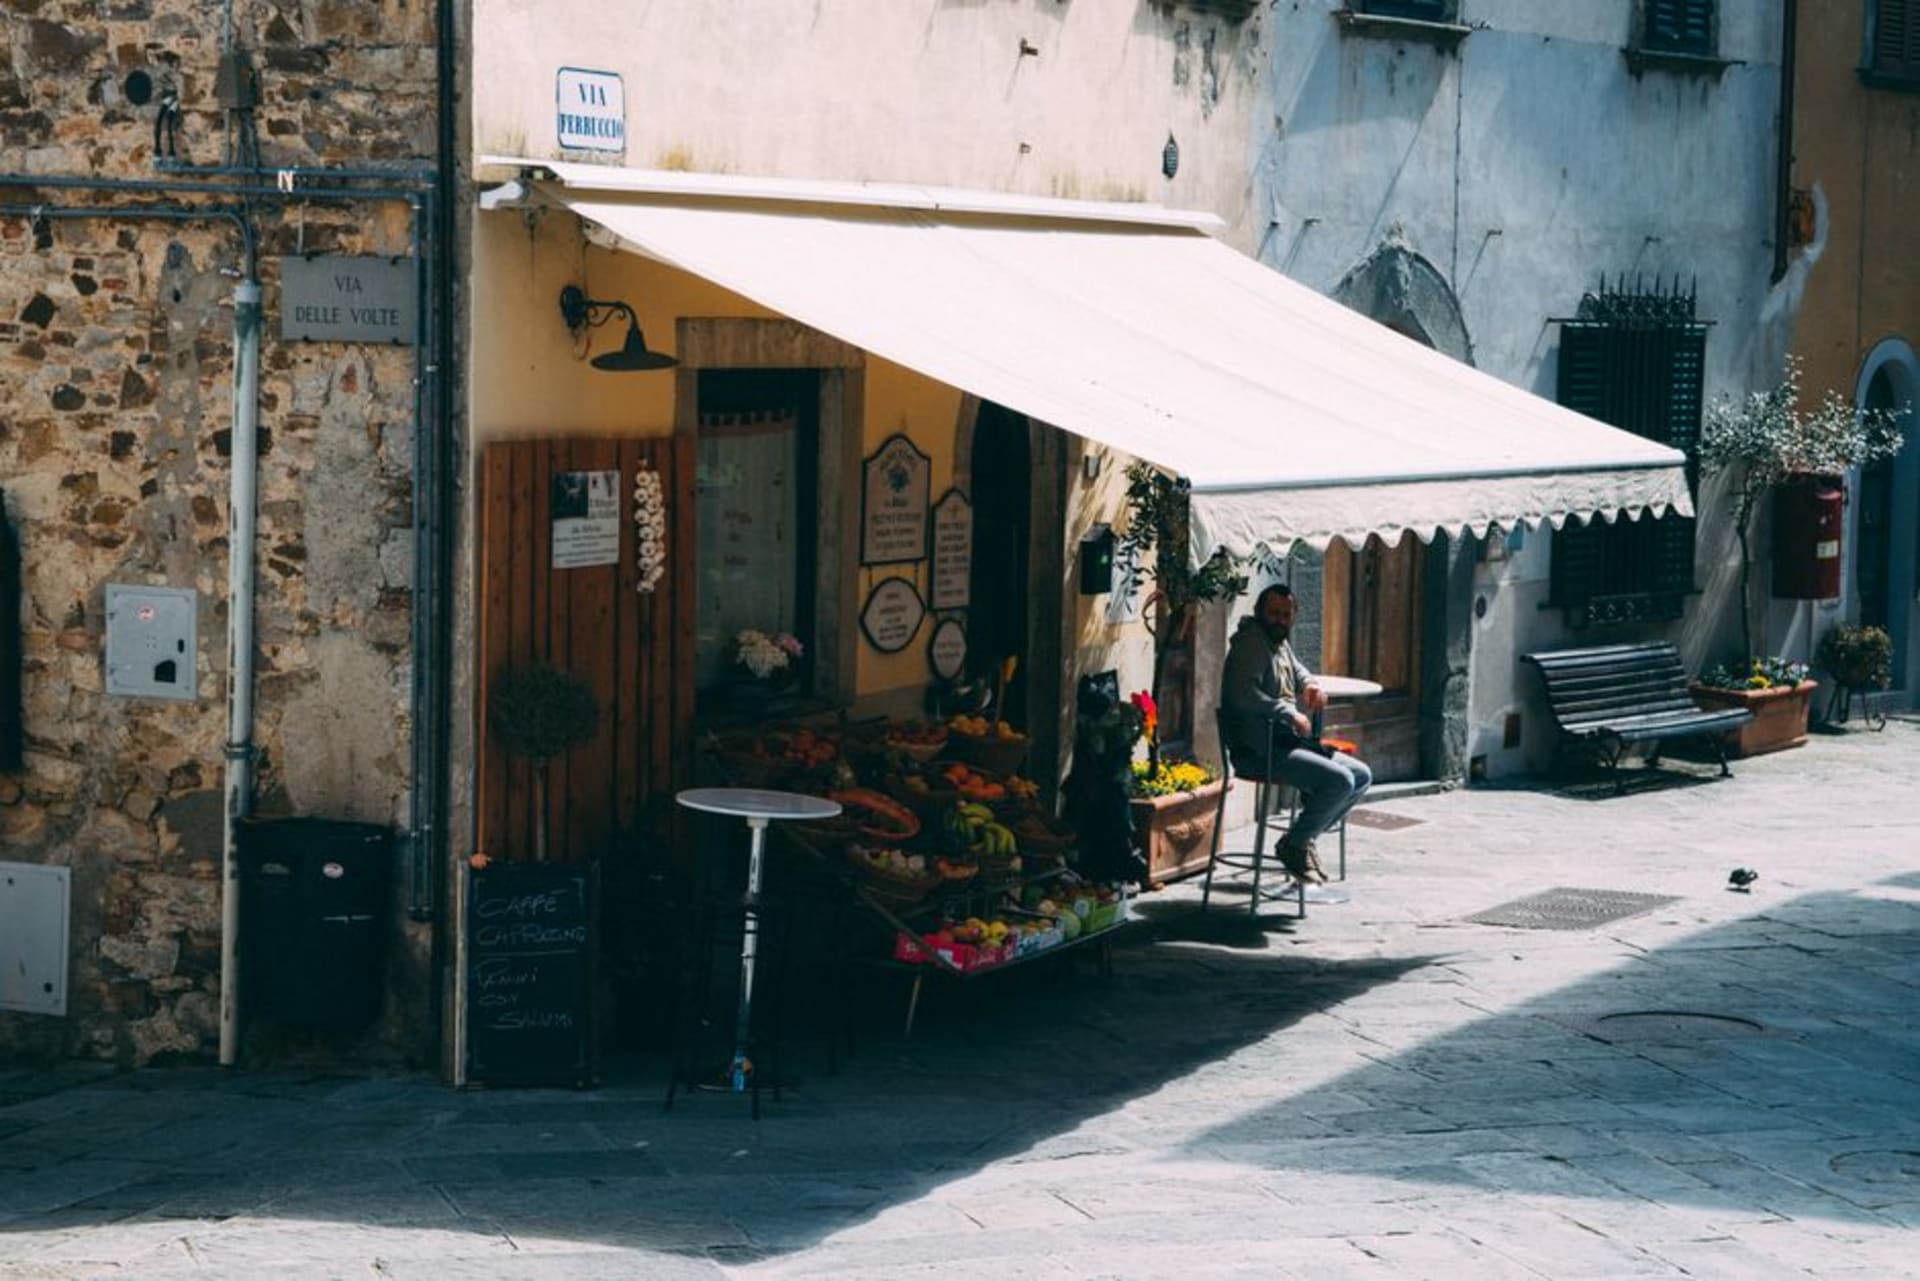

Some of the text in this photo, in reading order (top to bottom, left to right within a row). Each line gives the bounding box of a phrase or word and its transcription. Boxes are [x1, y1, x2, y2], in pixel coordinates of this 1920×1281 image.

[578, 83, 606, 106] VIA
[334, 275, 363, 293] VIA
[295, 306, 400, 326] DELLE VOLTE
